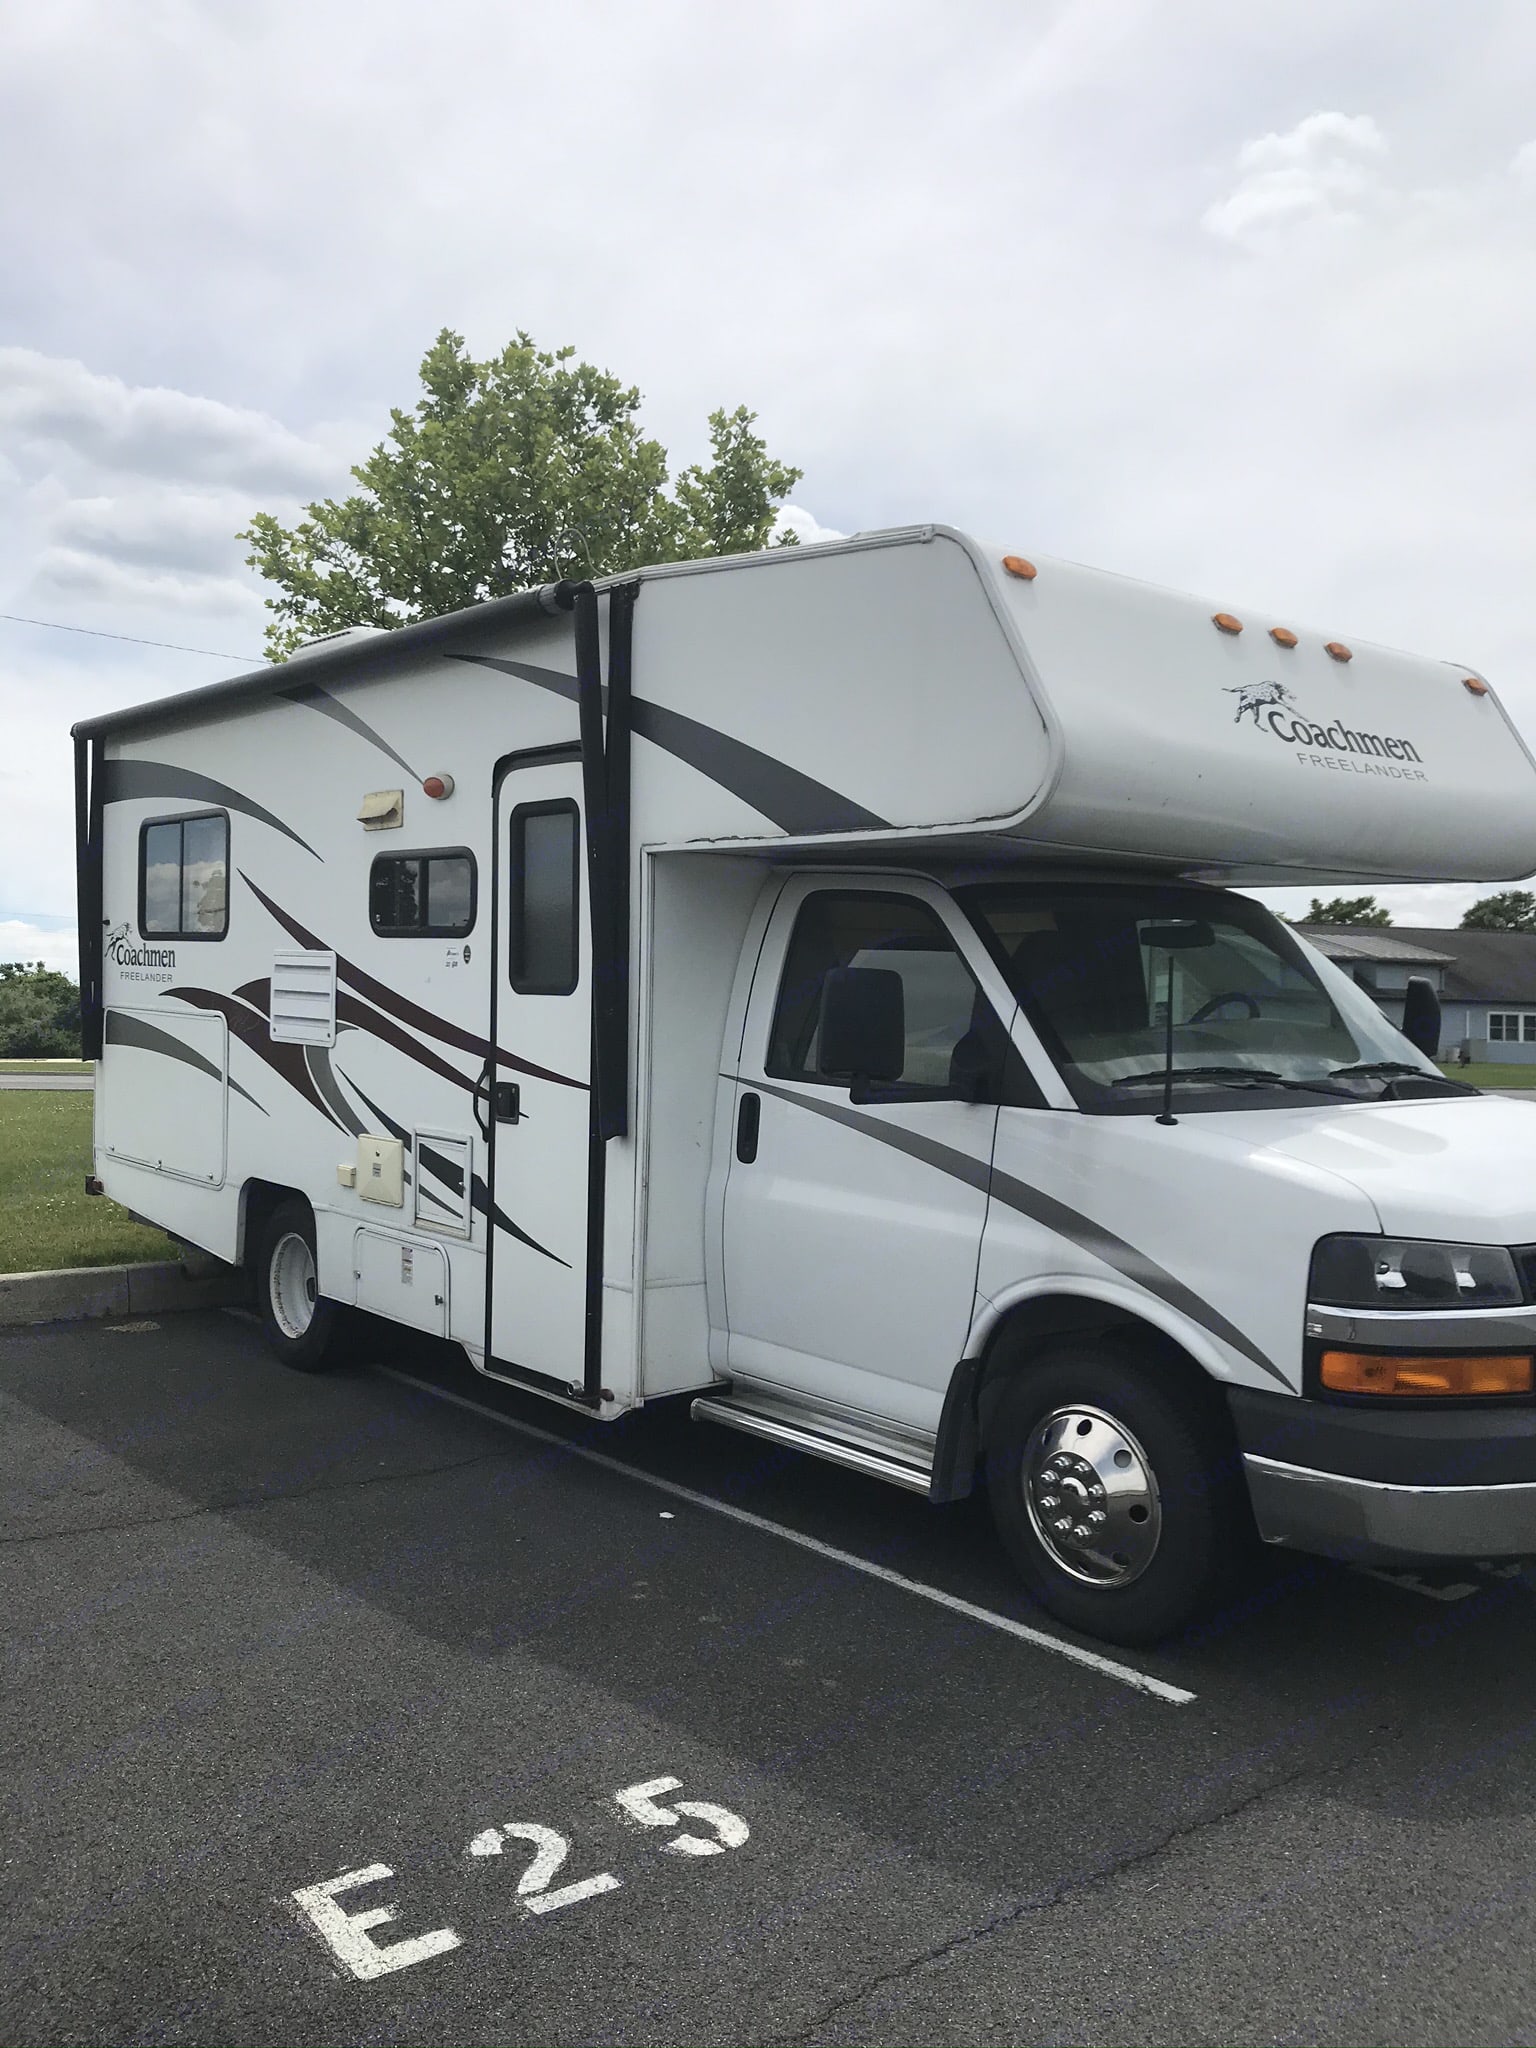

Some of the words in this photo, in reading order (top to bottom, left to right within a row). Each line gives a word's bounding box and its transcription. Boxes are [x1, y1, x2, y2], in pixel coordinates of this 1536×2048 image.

[1267, 710, 1424, 763] Coachmen
[1296, 752, 1428, 782] FREELANDER
[116, 942, 176, 968] Coachmen
[120, 971, 174, 983] FREELANDER
